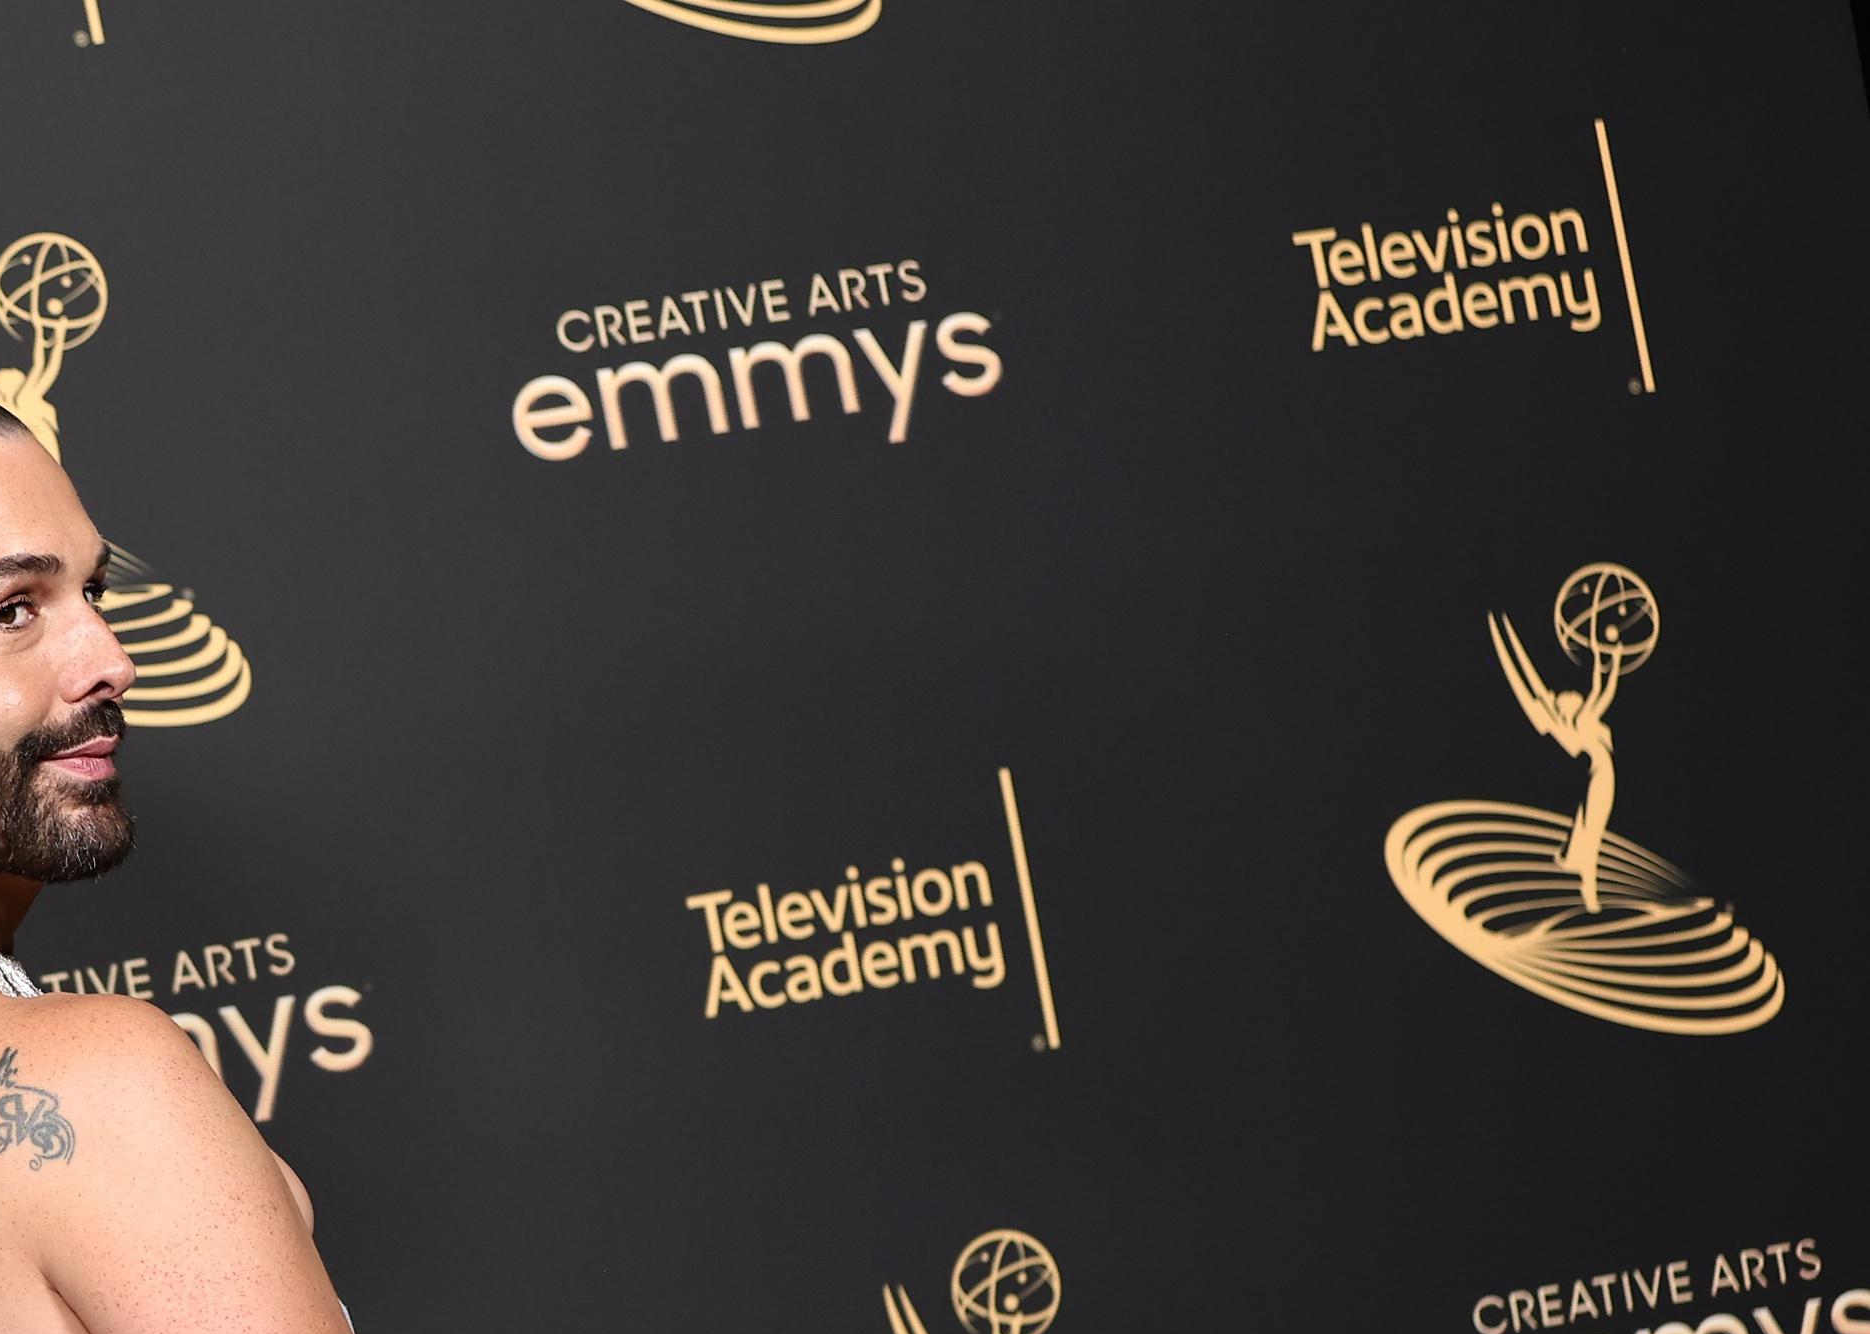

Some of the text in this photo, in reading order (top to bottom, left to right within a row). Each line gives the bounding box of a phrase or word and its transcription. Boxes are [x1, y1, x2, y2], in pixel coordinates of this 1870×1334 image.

[1293, 203, 1588, 288] Television
[556, 260, 926, 352] CREATIVE ARTS
[1312, 270, 1600, 351] Academy
[512, 312, 1002, 461] emmys
[686, 858, 992, 953] Television
[172, 933, 295, 994] ARTS
[705, 923, 1005, 1018] Academy
[1712, 1239, 1821, 1296] ARTS
